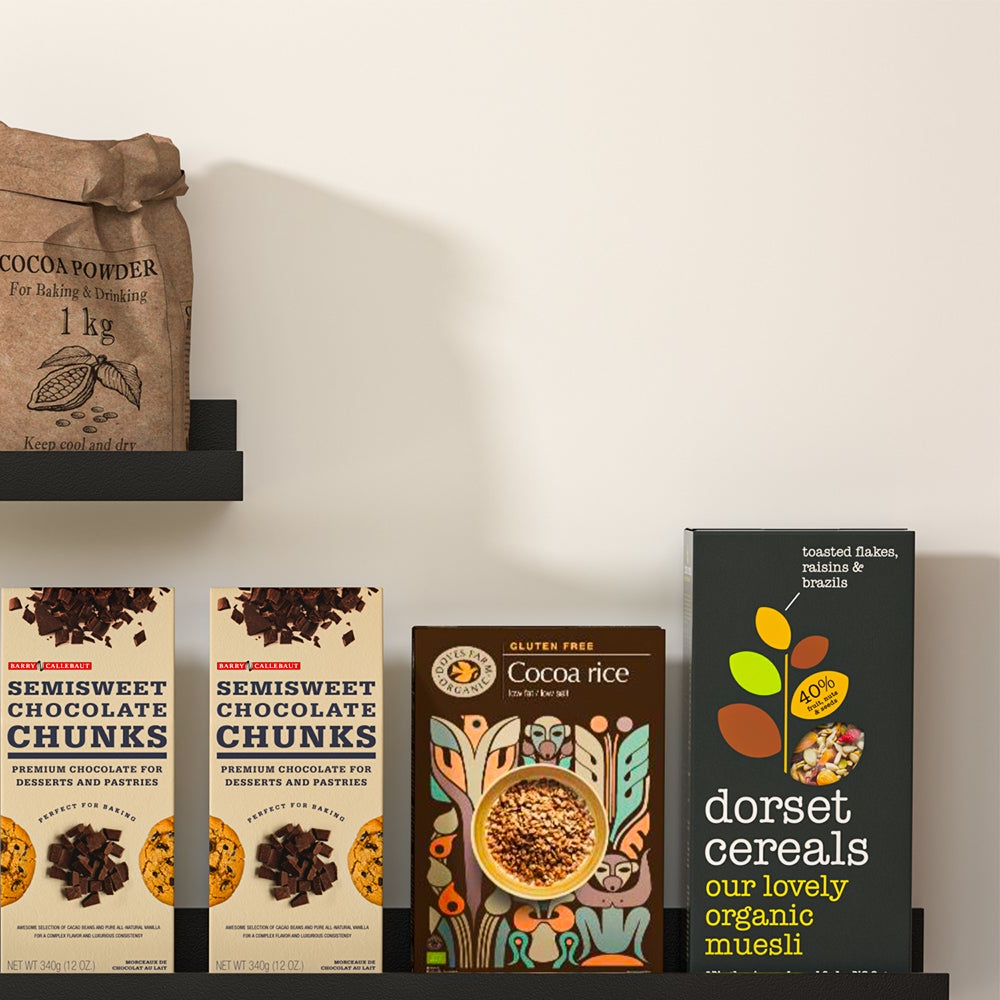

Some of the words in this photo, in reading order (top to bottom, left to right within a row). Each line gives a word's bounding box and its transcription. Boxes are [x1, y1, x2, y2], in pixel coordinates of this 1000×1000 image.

[72, 258, 158, 281] POWDER
[10, 282, 32, 296] For
[36, 282, 79, 300] Baking
[82, 285, 92, 298] &
[95, 287, 148, 304] Drinking
[61, 306, 70, 335] 1
[82, 306, 116, 346] kg
[24, 436, 56, 451] Keep
[60, 437, 86, 450] cool
[89, 438, 112, 450] and
[115, 438, 137, 451] dry
[802, 546, 852, 557] toasted
[855, 546, 898, 559] flakes,
[802, 561, 849, 573] raisins
[852, 561, 864, 573] &
[802, 577, 848, 588] brazils
[510, 642, 557, 651] GLUTEN
[563, 642, 593, 651] FREE
[507, 661, 581, 683] Cocoa
[588, 661, 629, 683] rice
[8, 681, 167, 696] SEMISWEET
[217, 681, 376, 696] SEMISWEET
[439, 676, 490, 694] ORGANIC
[800, 676, 836, 704] 40%
[824, 691, 838, 702] nuts
[8, 702, 167, 718] CHOCOLATE
[217, 702, 376, 718] CHOCOLATE
[820, 698, 838, 712] seeds
[7, 725, 167, 748] CHUNKS
[216, 725, 376, 748] CHUNKS
[12, 765, 66, 773] PREMIUM
[69, 765, 137, 773] CHOCOLATE
[141, 765, 163, 773] FOR
[221, 765, 275, 773] PREMIUM
[278, 765, 346, 773] CHOCOLATE
[350, 765, 372, 773] FOR
[16, 778, 73, 786] DESSERTS
[76, 778, 101, 786] AND
[104, 778, 158, 786] PASTRIES
[225, 778, 282, 786] DESSERTS
[285, 778, 310, 786] AND
[313, 778, 367, 786] PASTRIES
[38, 803, 77, 824] PERFECT
[103, 804, 137, 822] BAKING
[247, 803, 286, 824] PERFECT
[312, 804, 346, 822] BAKING
[705, 788, 851, 824] dorset
[705, 830, 869, 866] cereals
[706, 879, 756, 897] our
[763, 874, 849, 902] lovely
[706, 903, 814, 931] organic
[705, 933, 803, 956] muesli
[7, 960, 24, 971] NET
[25, 960, 38, 971] WT
[40, 960, 61, 973] 340g
[64, 960, 76, 972] (12
[78, 960, 96, 972] OZ.)
[216, 960, 231, 971] NET
[234, 960, 246, 971] WT
[248, 960, 270, 973] 340g
[272, 960, 285, 972] (12
[287, 960, 304, 972] OZ.)
